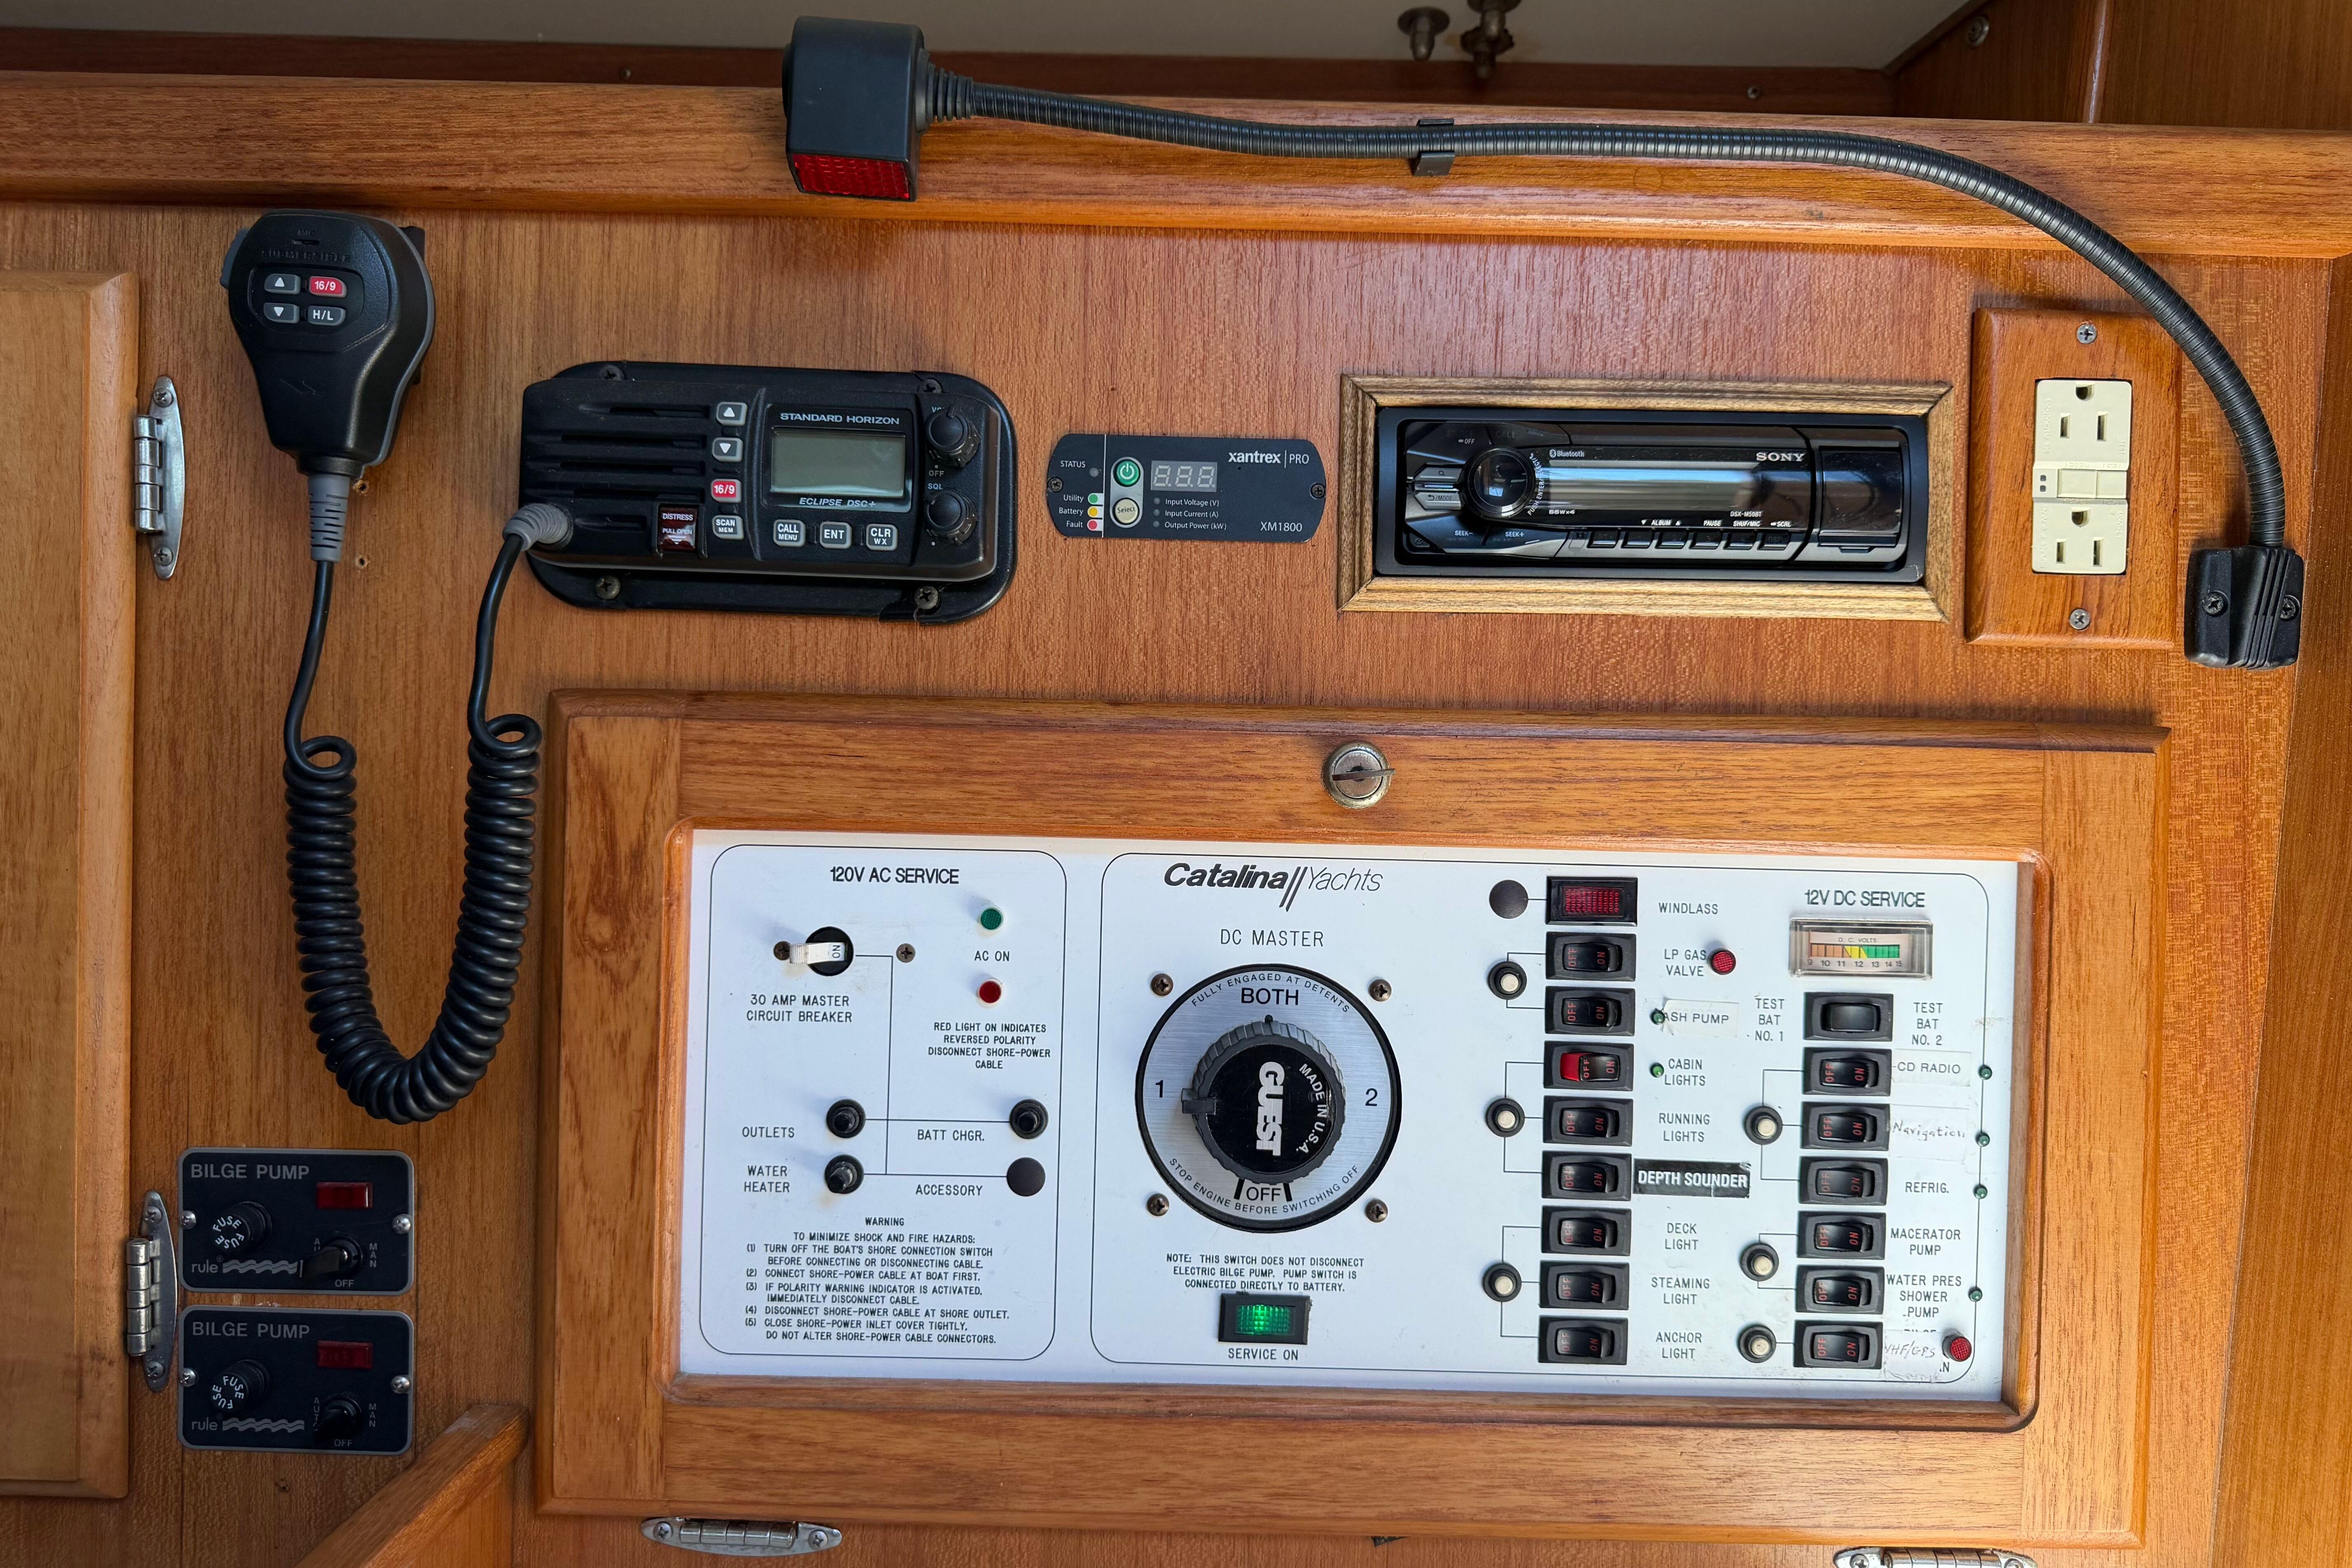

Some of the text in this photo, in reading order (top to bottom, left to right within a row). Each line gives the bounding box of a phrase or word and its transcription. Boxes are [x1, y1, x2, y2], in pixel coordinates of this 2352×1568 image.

[315, 280, 336, 291] 16/9
[313, 309, 334, 320] H/L
[780, 413, 899, 425] STANDARD HORIZON
[1228, 450, 1309, 464] xantrex PRO
[1756, 452, 1805, 462] SONY
[714, 484, 735, 494] 16/9
[799, 497, 842, 506] ECLIPSE
[1063, 494, 1084, 503] Utility
[1184, 499, 1208, 507] Voltage
[663, 513, 693, 521] DISTRESS
[1059, 507, 1084, 516] Battery
[777, 523, 799, 533] CALL
[1164, 521, 1188, 530] Output
[1260, 521, 1302, 532] XM1800
[824, 529, 845, 539] ENT
[870, 527, 891, 537] CLR
[830, 866, 959, 884] 120V AC SERVICE
[1164, 863, 1383, 891] Catalina Yachts
[1804, 889, 1925, 908] 12V DC SERVICE
[1658, 902, 1718, 915] WINDLASS
[1220, 929, 1323, 947] DC MASTER
[832, 945, 841, 959] ON
[974, 950, 1010, 961] AC ON
[1664, 949, 1706, 960] LP GAS
[1666, 965, 1704, 977] VALVE
[1192, 974, 1350, 1013] FULLY ENGAGED AT DETENTS
[1241, 987, 1299, 1006] BOTH
[751, 994, 849, 1006] 30 AMP MASTER
[1755, 998, 1785, 1009] TEST
[1913, 1002, 1943, 1013] TEST
[747, 1010, 852, 1022] CIRCUIT BREAKER
[1692, 1014, 1729, 1024] PUMP
[1759, 1014, 1781, 1025] BAT
[934, 1022, 1046, 1033] RED LIGHT ON INDICATES
[1917, 1018, 1939, 1029] BAT
[944, 1034, 1036, 1045] REVERSED POLARITY
[1755, 1030, 1783, 1041] NO. 1
[1911, 1034, 1942, 1045] NO. 2
[928, 1047, 1050, 1057] DISCONNECT SHORE-POWER
[975, 1060, 1003, 1069] CABLE
[1668, 1058, 1702, 1070] CABIN
[1897, 1062, 1961, 1074] CD RADIO
[1664, 1074, 1706, 1086] LIGHTS
[1155, 1080, 1163, 1098] 1
[1365, 1088, 1378, 1106] 2
[1256, 1061, 1284, 1156] GUEST
[1296, 1063, 1328, 1153] MADE IN U.S.A.
[1659, 1113, 1710, 1125] RUNNING
[742, 1126, 795, 1138] OUTLETS
[917, 1129, 985, 1141] BATT CHGR.
[1663, 1130, 1704, 1142] LIGHTS
[1892, 1122, 1965, 1141] Navigation
[191, 1163, 309, 1179] BILGE PUMP
[747, 1165, 787, 1176] WATER
[1638, 1170, 1748, 1188] DEPTH SOUNDER
[744, 1181, 790, 1193] HEATER
[915, 1184, 983, 1196] ACCESSORY
[1170, 1158, 1359, 1214] STOP ENGINE BEFORE SWITCHING OFF
[1905, 1181, 1949, 1193] REFRIG.
[1246, 1187, 1281, 1202] OFF
[212, 1215, 242, 1232] FUSE
[865, 1217, 904, 1226] WARNING
[1667, 1223, 1696, 1234] DECK
[1890, 1228, 1960, 1240] MACERATOR
[215, 1232, 245, 1249] FUSE
[793, 1232, 975, 1244] TO MINIMIZE SHOCK AND FIRE HAZARDS:
[747, 1243, 992, 1256] (1) TURN OFF THE BOAT'S SHORE CONNECTION SWITCH
[1665, 1239, 1699, 1250] LIGHT
[1909, 1244, 1941, 1255] PUMP
[191, 1259, 218, 1273] rule
[1651, 1277, 1710, 1289] STEAMING
[1886, 1274, 1962, 1287] WATER PRES
[1664, 1293, 1697, 1304] LIGHT
[1899, 1290, 1947, 1302] SHOWER
[1908, 1307, 1939, 1318] PUMP
[193, 1321, 310, 1339] BILGE PUMP
[1655, 1332, 1702, 1343] ANCHOR
[1228, 1348, 1298, 1360] SERVICE ON
[1662, 1347, 1695, 1359] LIGHT
